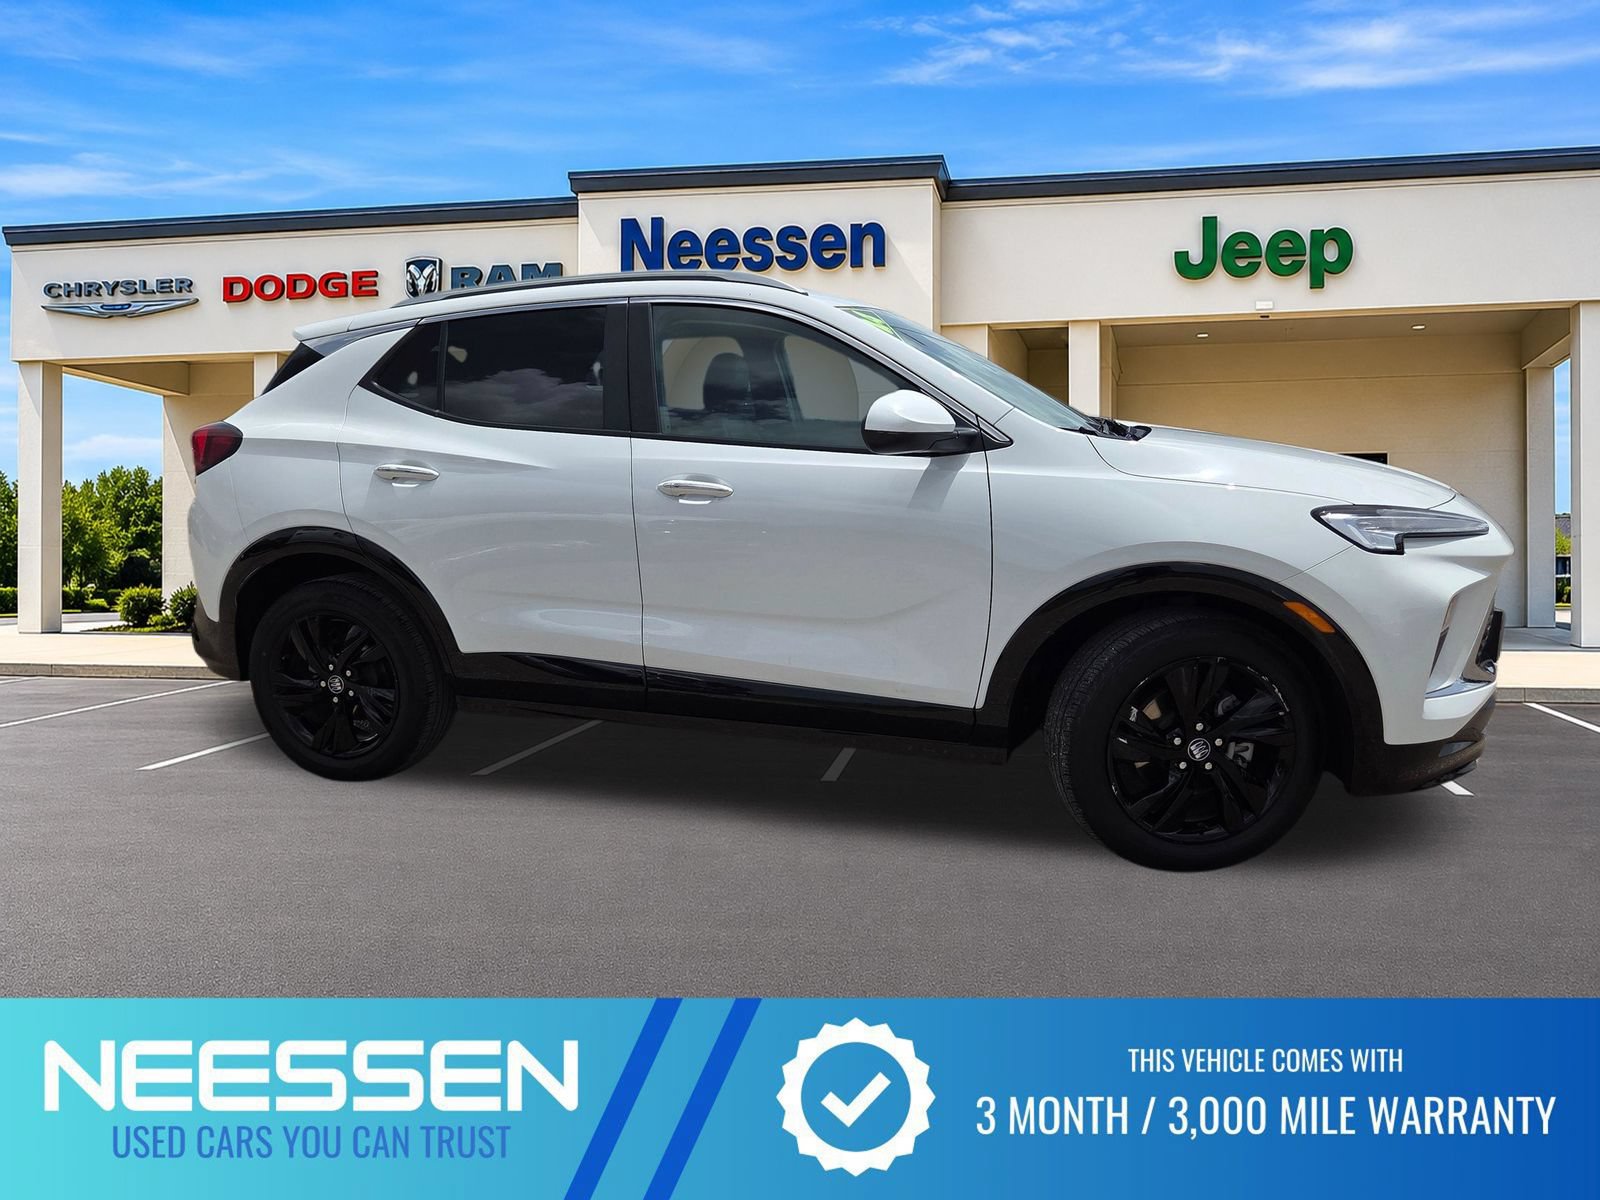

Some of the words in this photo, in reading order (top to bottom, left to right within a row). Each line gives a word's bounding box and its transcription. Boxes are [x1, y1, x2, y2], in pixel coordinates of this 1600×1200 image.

[620, 216, 886, 271] Neessen
[1174, 215, 1354, 289] Jeep
[43, 277, 194, 299] CHRYSLER
[222, 270, 378, 303] DODGE
[450, 262, 563, 289] RAM
